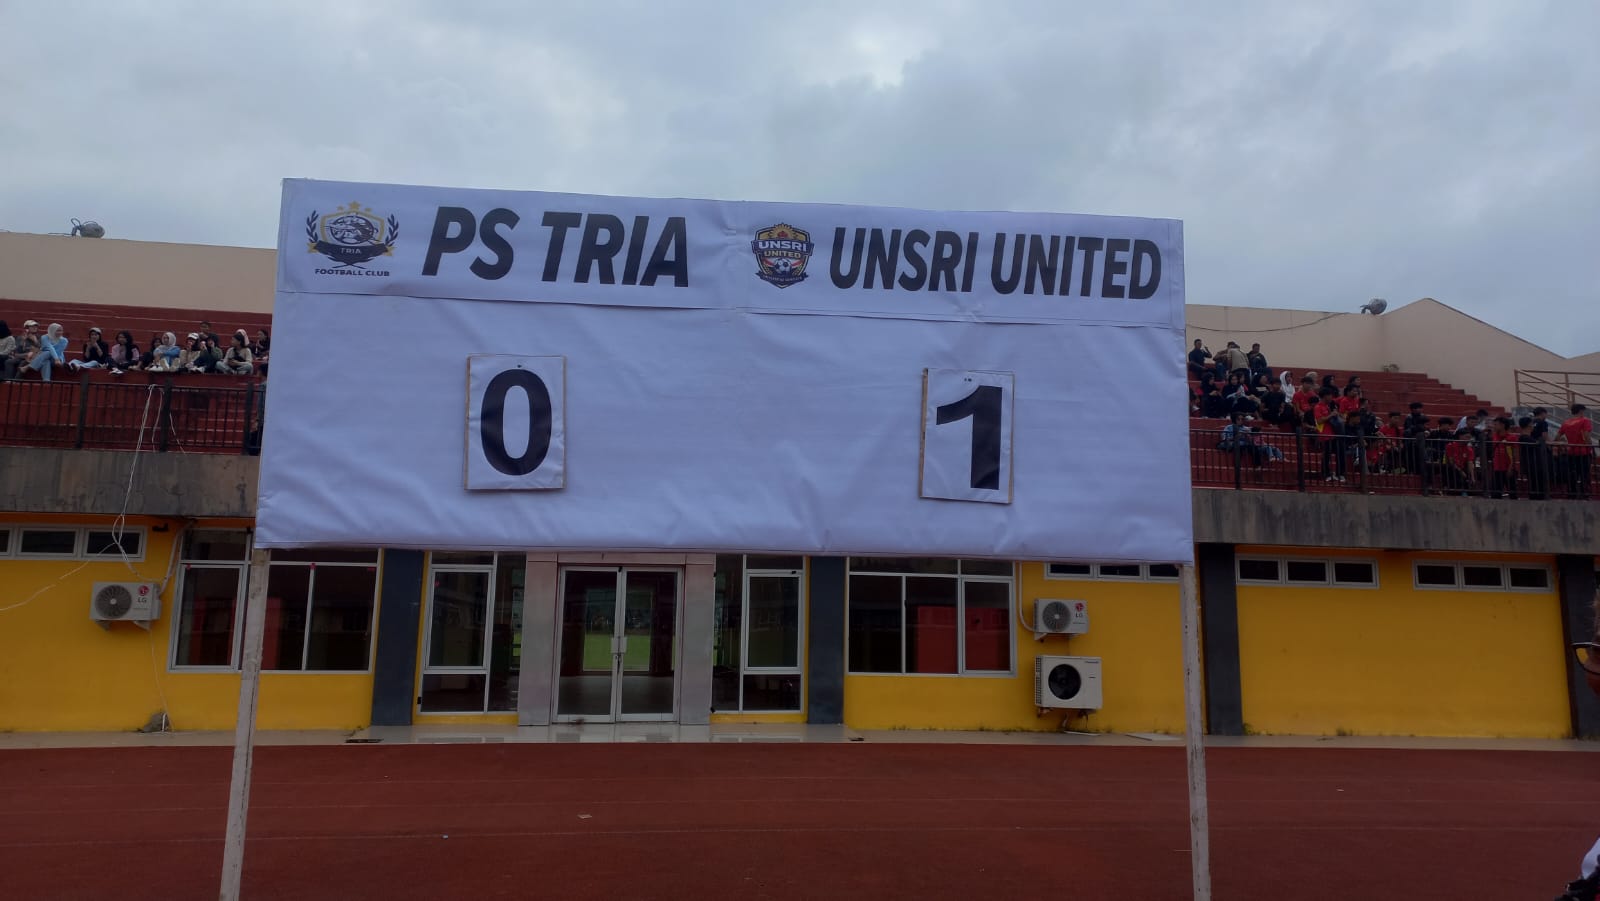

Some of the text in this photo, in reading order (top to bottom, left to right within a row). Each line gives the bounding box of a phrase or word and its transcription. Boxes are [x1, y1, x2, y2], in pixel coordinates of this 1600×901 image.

[315, 268, 363, 276] FOOTBALL
[422, 206, 689, 288] PS TRIA
[758, 240, 807, 252] UNSRI
[764, 250, 801, 258] UNITED
[829, 226, 1162, 300] UNSRI UNITED
[481, 369, 552, 476] 0
[936, 384, 1003, 490] 1
